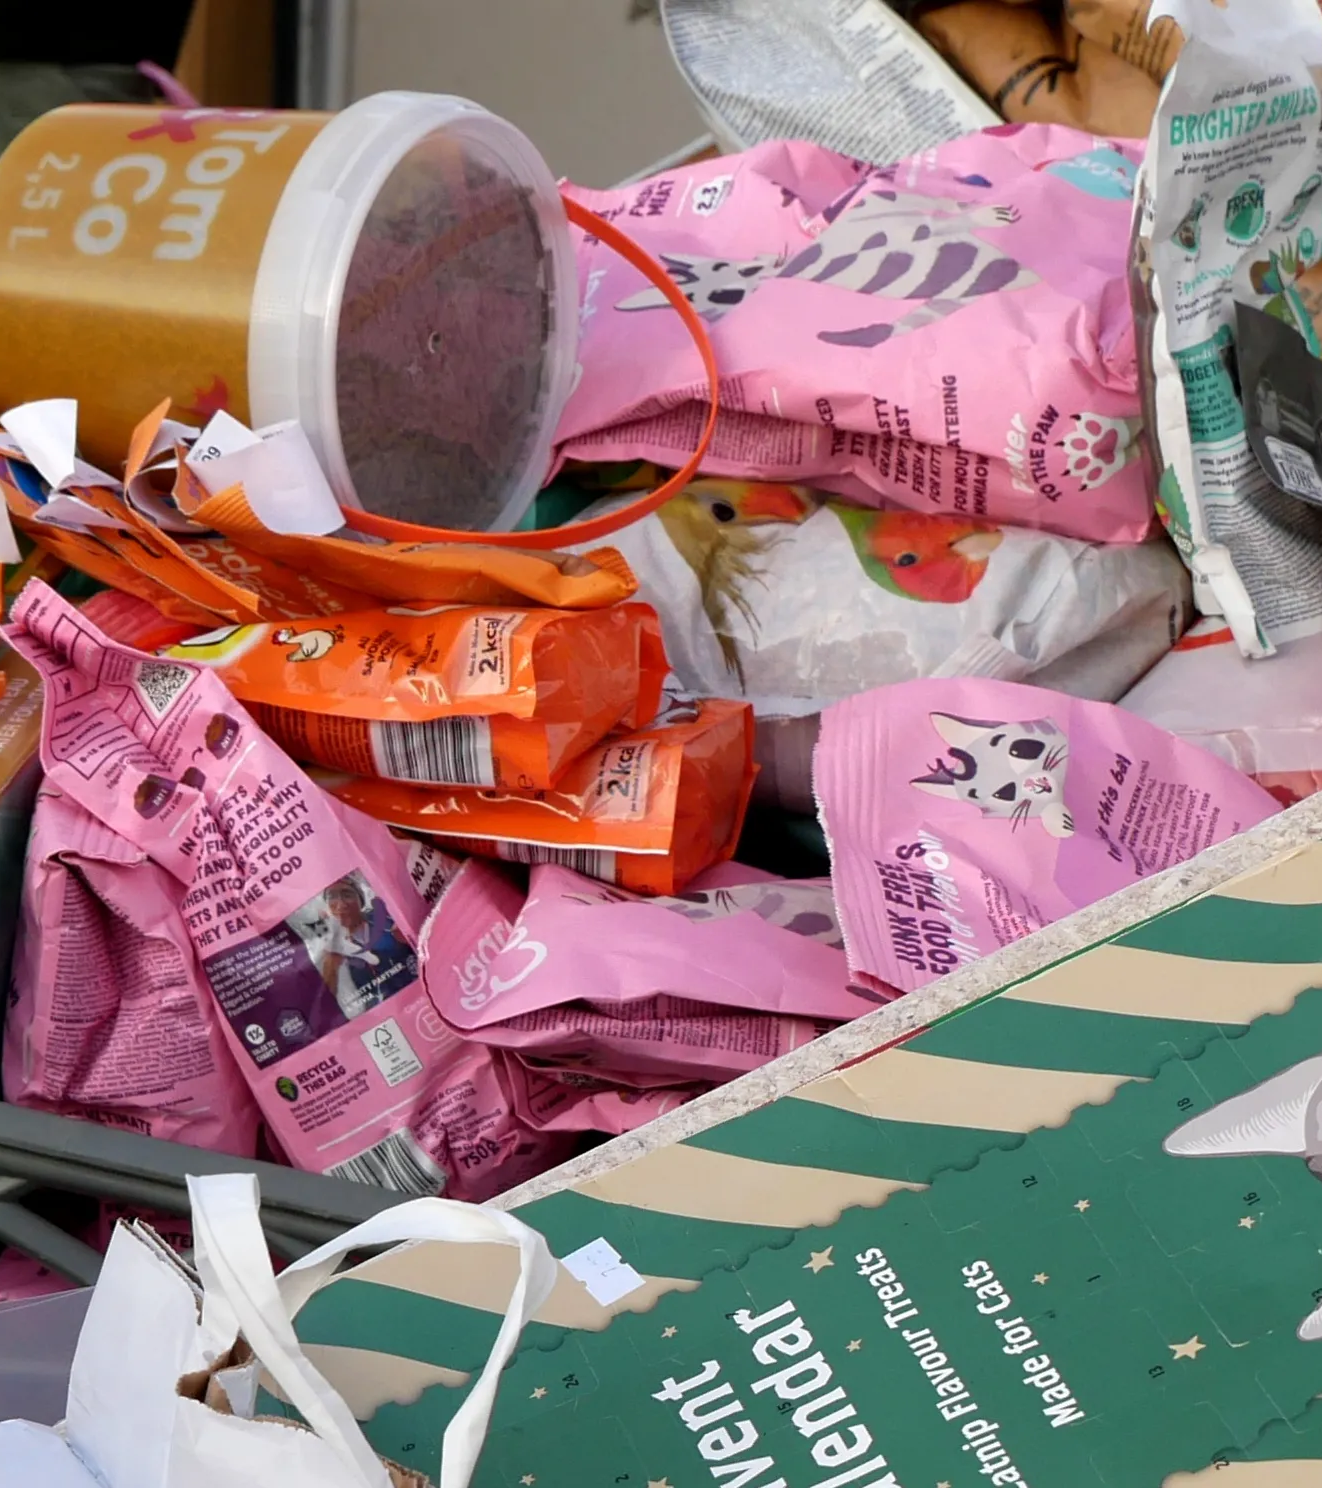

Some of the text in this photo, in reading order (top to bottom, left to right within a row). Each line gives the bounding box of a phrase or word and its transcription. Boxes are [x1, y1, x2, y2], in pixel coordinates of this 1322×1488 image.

[73, 152, 167, 256] Co
[151, 125, 290, 261] Tom
[1029, 404, 1063, 502] TO THE PAW
[479, 617, 502, 673] 2 kcal
[238, 774, 277, 820] FAMILY
[270, 780, 304, 810] WHY
[607, 745, 636, 797] 2 kcal
[243, 800, 311, 857] EQUALITY
[1098, 785, 1120, 826] this
[257, 822, 316, 867] TO OUR
[264, 855, 303, 891] FOOD
[874, 860, 928, 971] JUNK FREE
[920, 920, 958, 975] FOOD
[296, 1055, 339, 1085] RECYCLE
[302, 1066, 347, 1095] THIS BAG
[854, 1245, 919, 1333] Treats
[959, 1259, 1086, 1429] Made for Cats
[898, 1325, 979, 1421] Flavour
